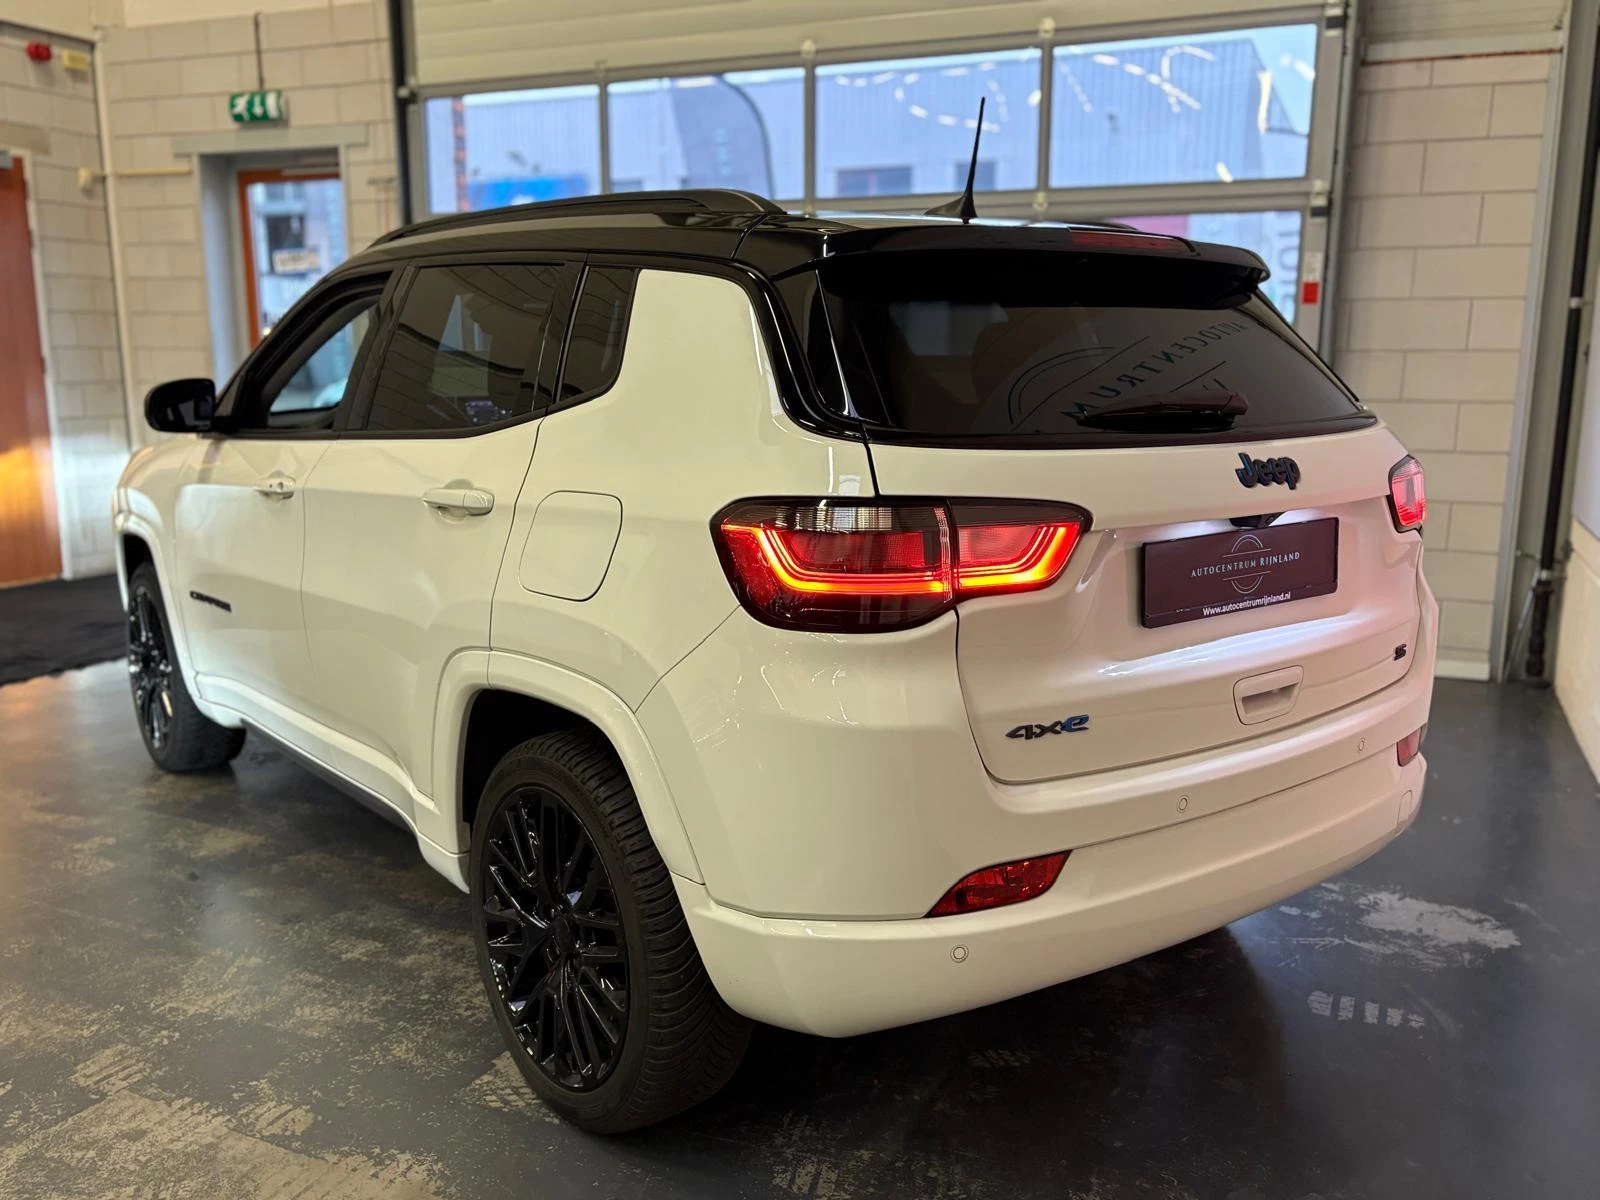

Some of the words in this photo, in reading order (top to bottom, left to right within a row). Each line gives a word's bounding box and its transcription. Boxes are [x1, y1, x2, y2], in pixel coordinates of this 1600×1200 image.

[1235, 452, 1301, 491] Jeep
[1191, 559, 1257, 578] AUTOCENTRUM
[1259, 551, 1301, 568] RIJNLAND
